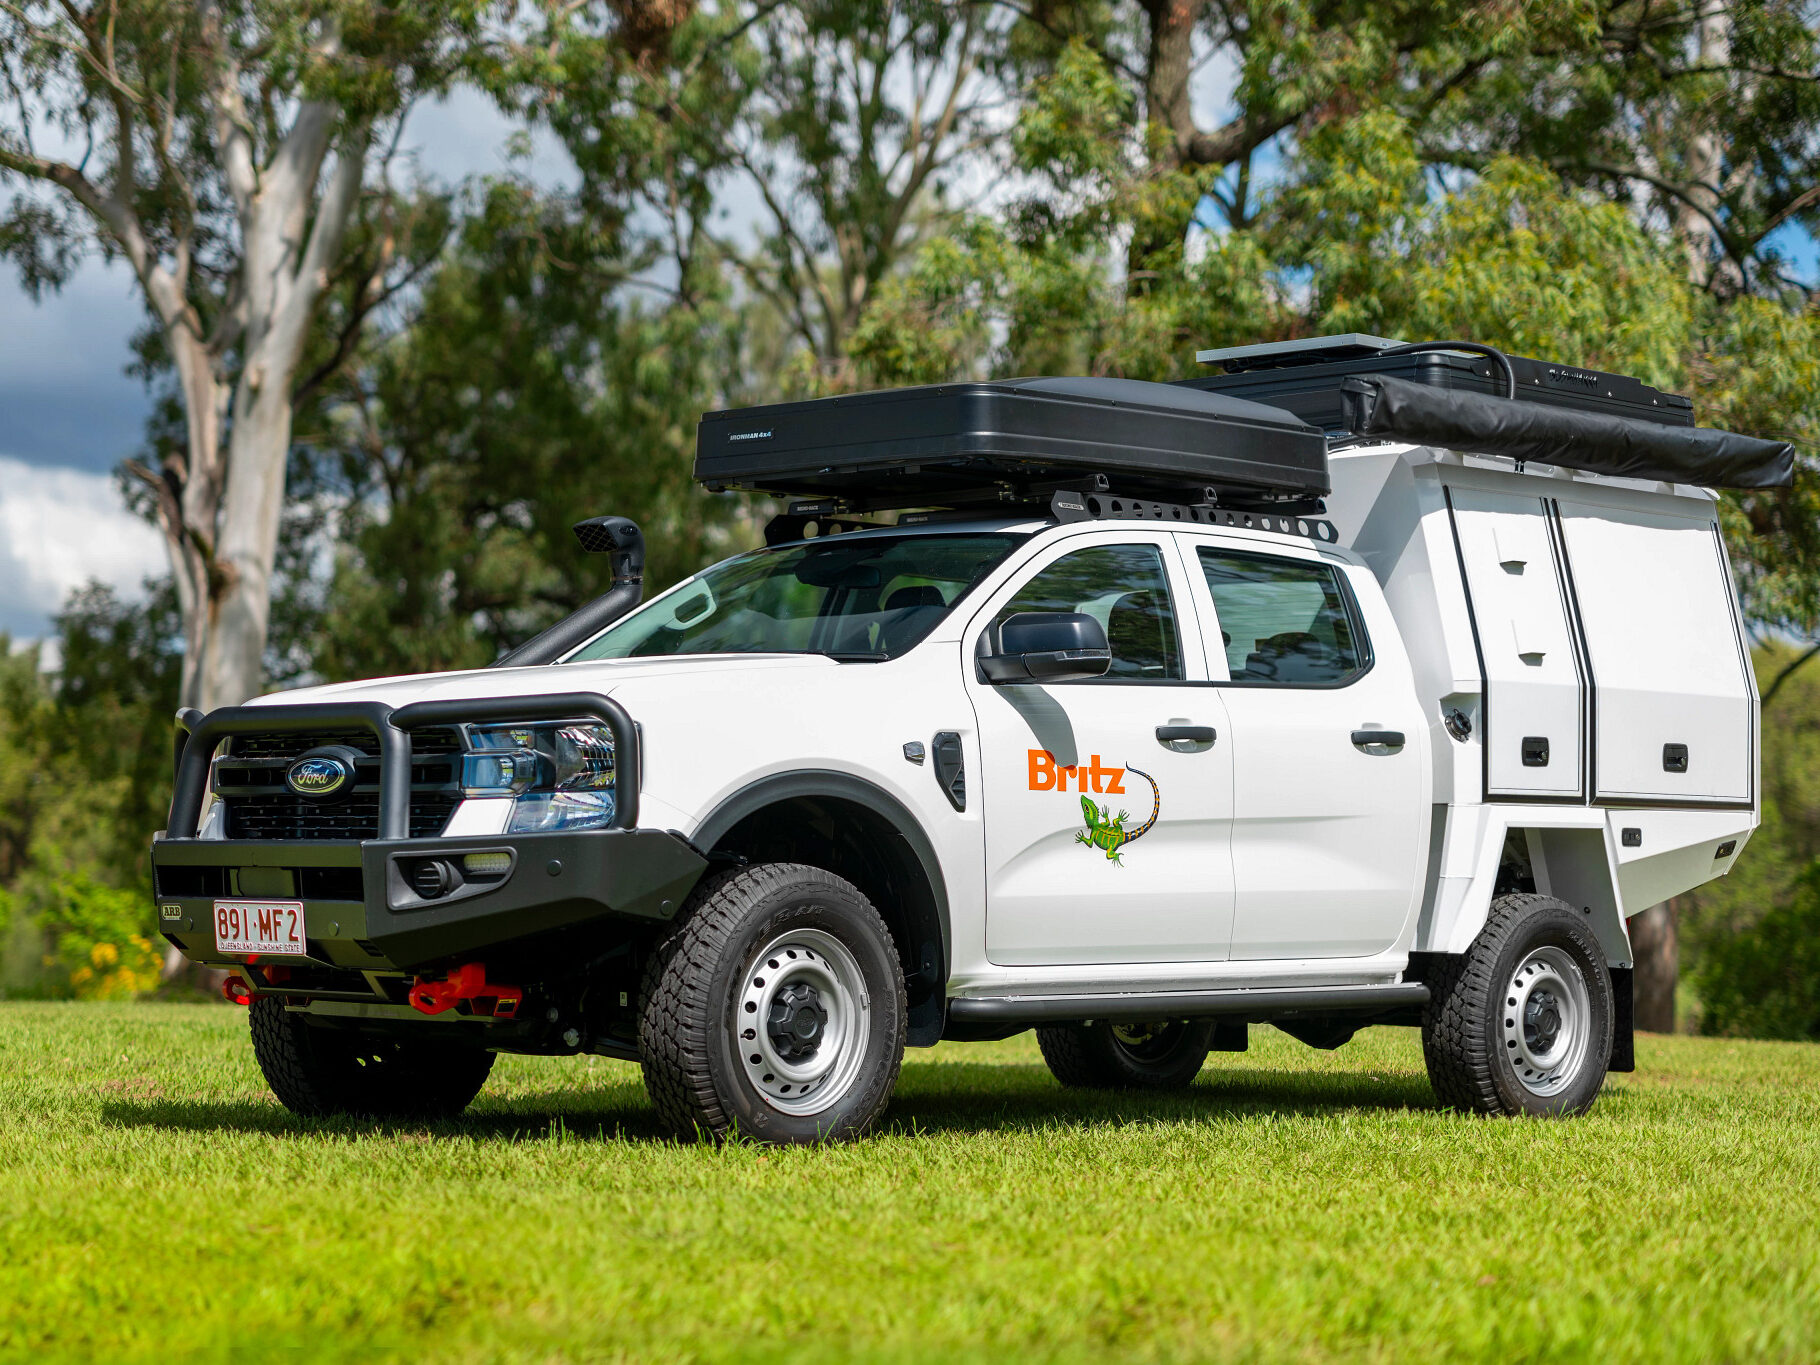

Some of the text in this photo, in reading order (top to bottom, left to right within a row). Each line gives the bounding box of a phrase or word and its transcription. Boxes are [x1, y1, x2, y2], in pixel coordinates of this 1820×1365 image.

[730, 433, 758, 441] IRONMAN
[298, 763, 330, 784] Ford
[1028, 749, 1126, 794] Britz
[164, 905, 180, 917] ARB
[220, 941, 300, 953] QUEENSLAND SUNSHINE STATE
